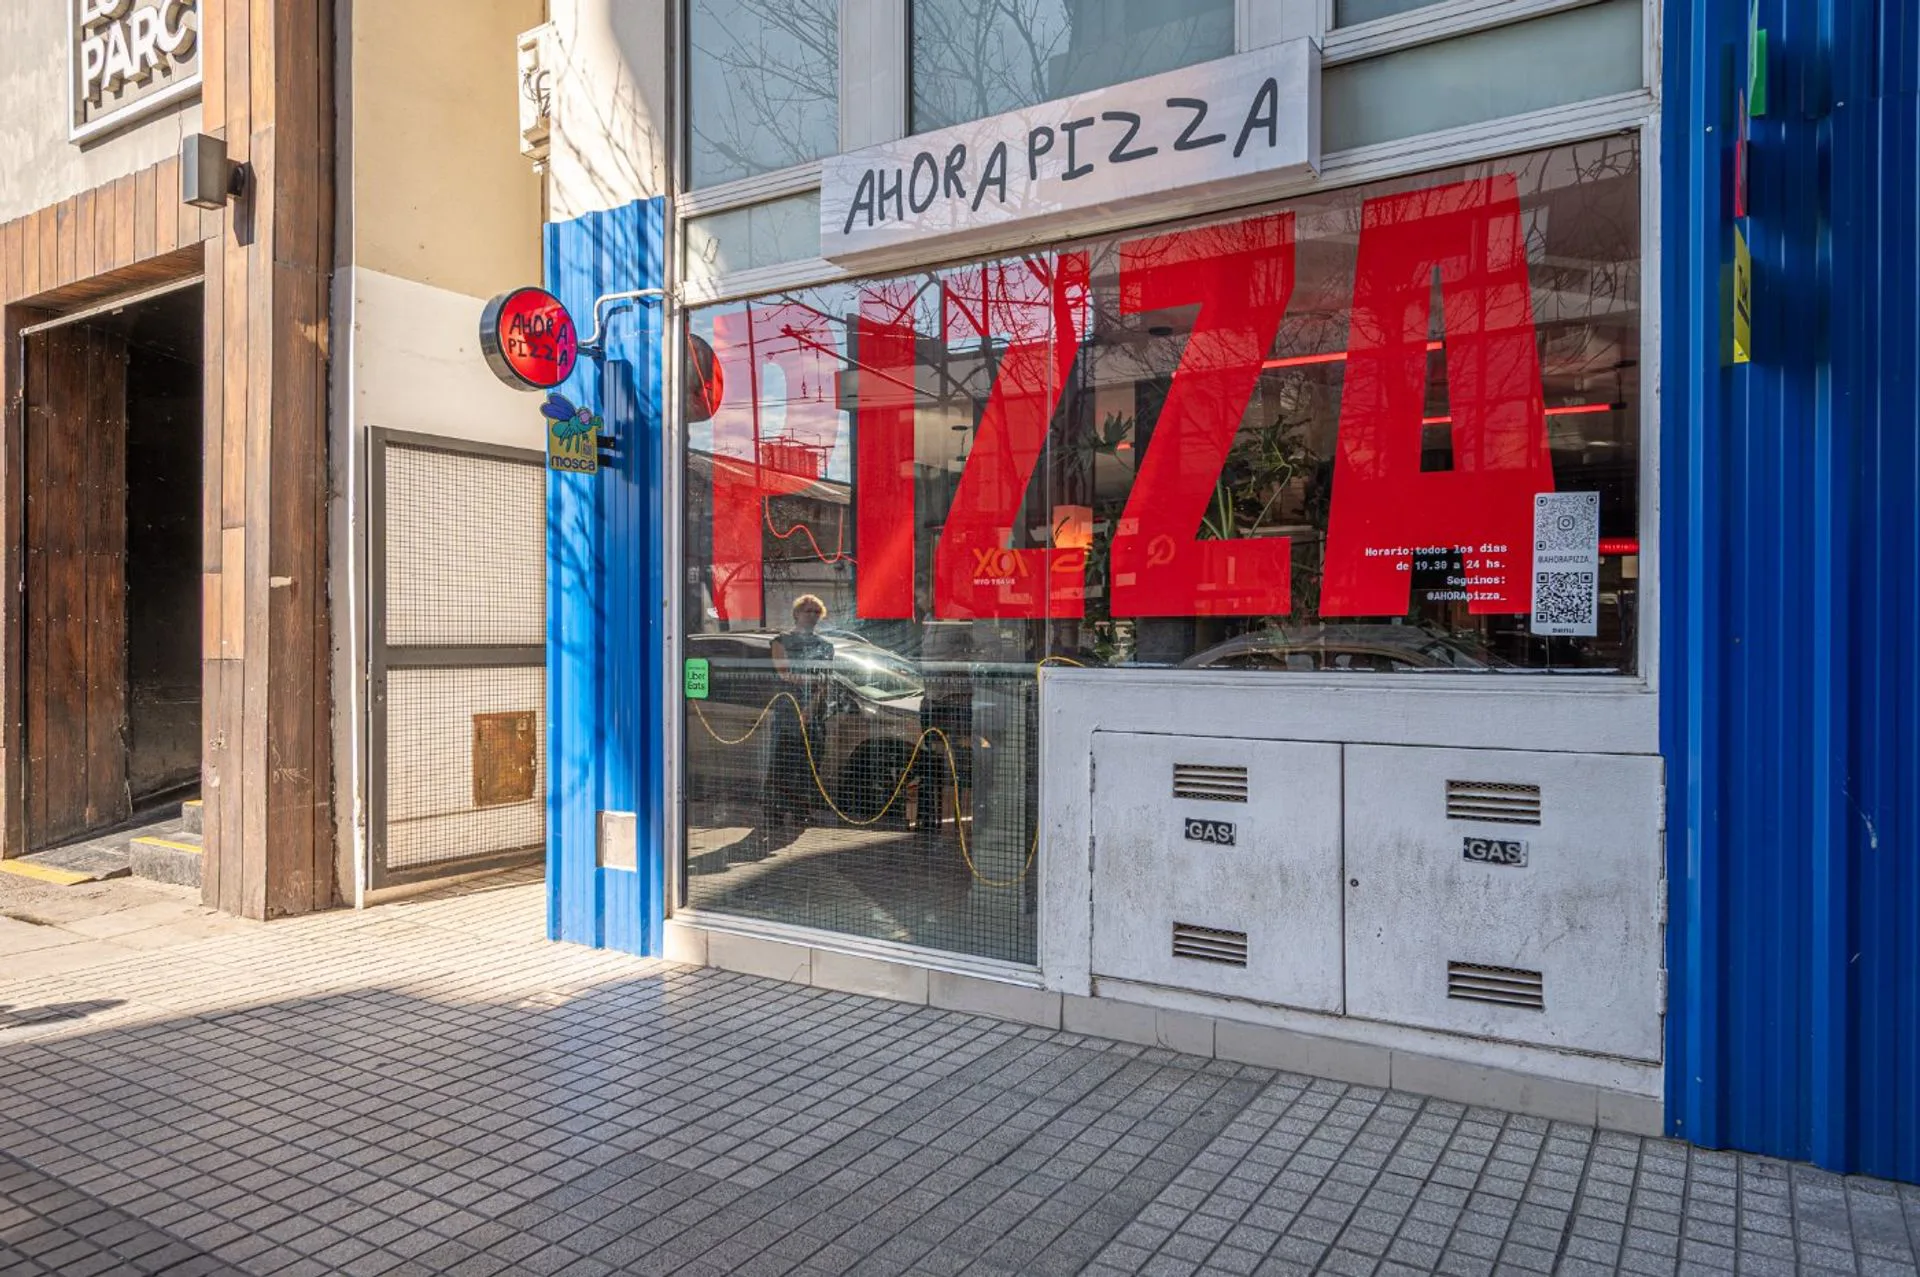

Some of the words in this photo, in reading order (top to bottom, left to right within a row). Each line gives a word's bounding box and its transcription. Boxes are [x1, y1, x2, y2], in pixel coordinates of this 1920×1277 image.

[81, 0, 198, 100] PARC
[844, 141, 1007, 234] AHORA
[1028, 77, 1279, 181] PIZZA
[509, 312, 569, 345] AHORA
[508, 337, 569, 366] PIZZA
[713, 173, 1555, 617] PIZZA
[552, 456, 595, 471] mosca
[1453, 544, 1473, 553] los
[1396, 561, 1409, 570] de
[1415, 560, 1447, 570] 19.30
[1453, 561, 1461, 569] a
[1466, 560, 1480, 569] 24
[1486, 559, 1506, 568] hs.
[1446, 575, 1506, 586] Seguinos:
[1426, 591, 1507, 602] @AHORApizza_
[687, 681, 705, 690] Eats
[1189, 822, 1230, 842] GAS
[1469, 841, 1520, 862] GAS
